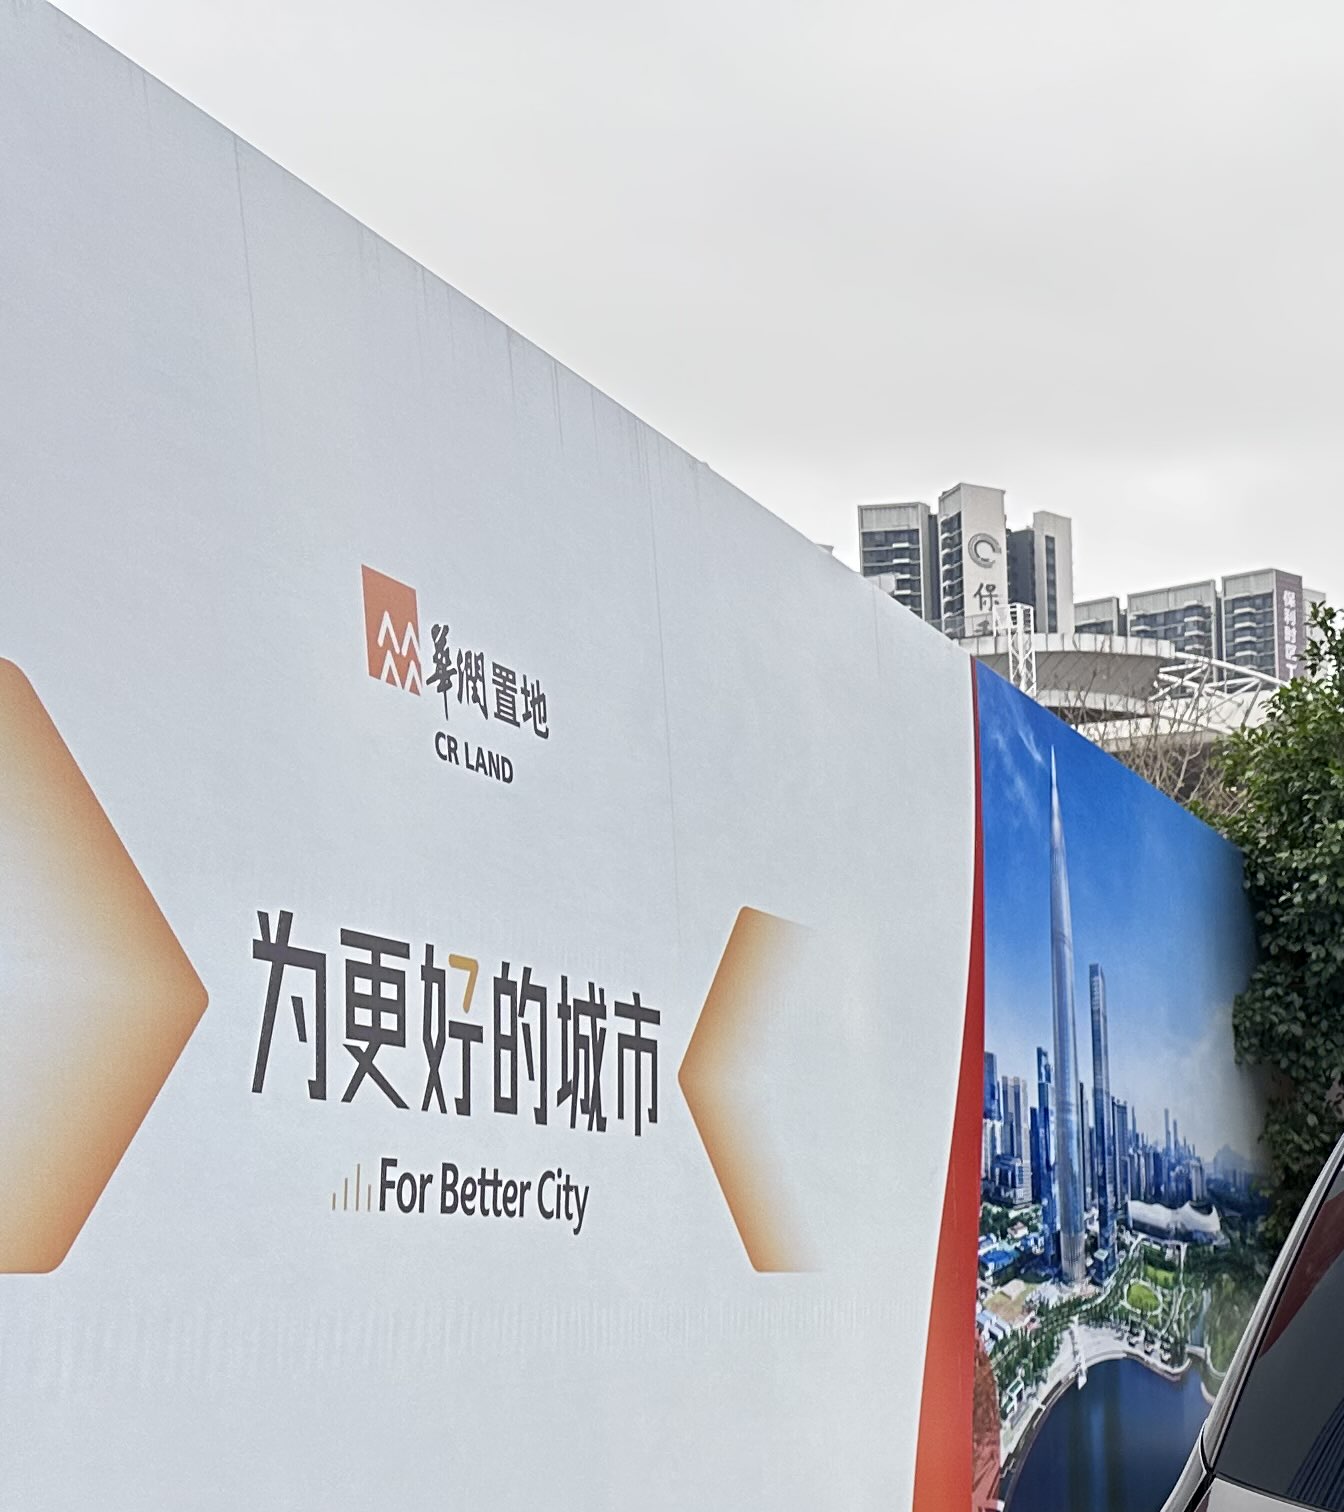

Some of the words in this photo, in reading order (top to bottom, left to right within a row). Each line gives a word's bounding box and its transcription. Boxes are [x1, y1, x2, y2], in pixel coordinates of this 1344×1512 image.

[434, 731, 459, 765] CR
[465, 742, 514, 784] LAND
[252, 910, 661, 1137] 为更好的城市
[379, 1158, 433, 1213] For
[440, 1162, 531, 1221] Better
[537, 1170, 590, 1234] City
